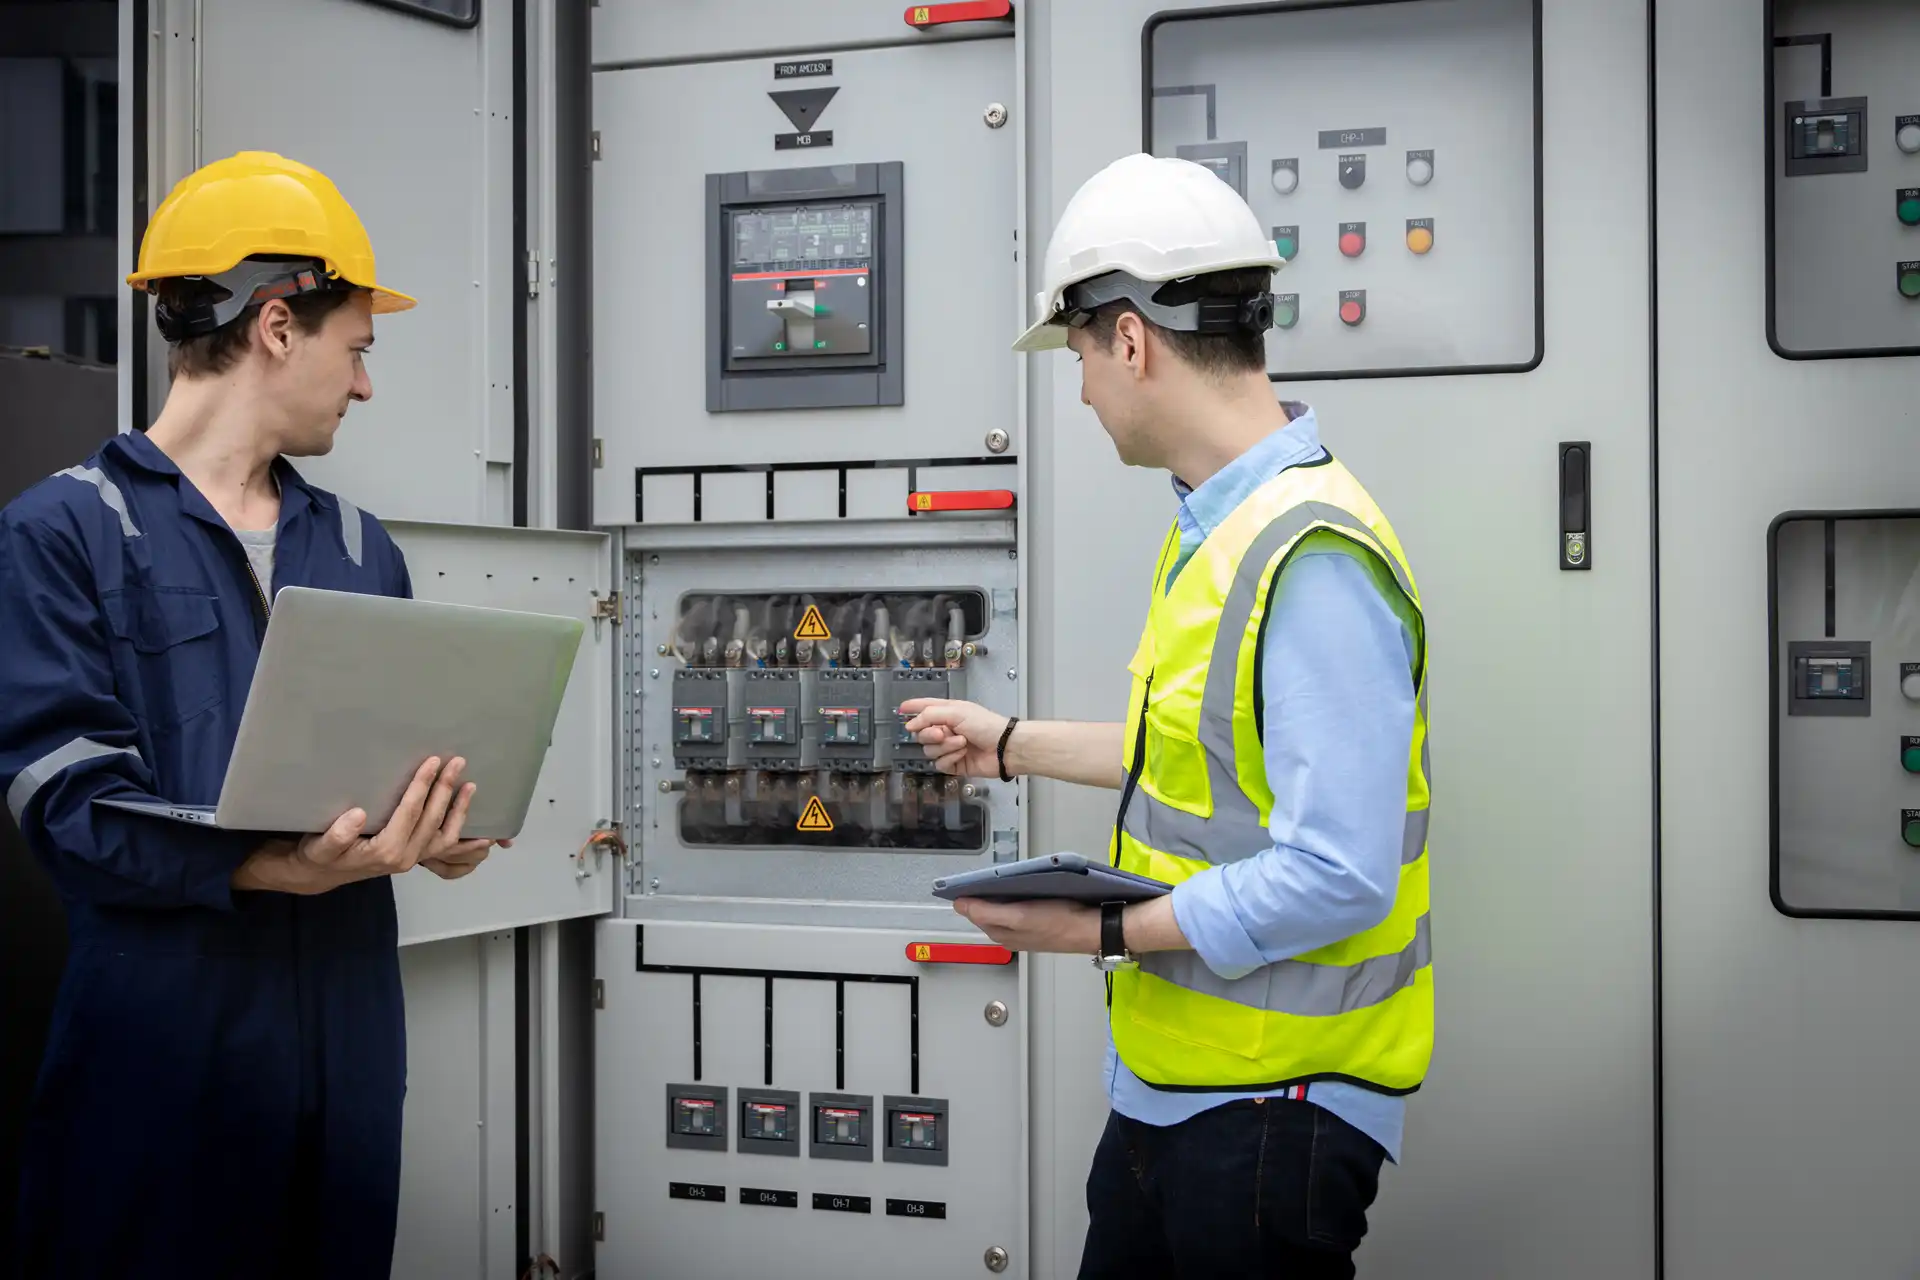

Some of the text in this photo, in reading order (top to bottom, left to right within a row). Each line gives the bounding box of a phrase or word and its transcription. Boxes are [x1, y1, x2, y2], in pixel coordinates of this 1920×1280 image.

[780, 65, 797, 75] FROM
[796, 135, 811, 145] MCB
[1902, 262, 1920, 270] STAR
[688, 1187, 706, 1197] CH-5
[760, 1193, 778, 1203] CH-6
[832, 1198, 850, 1208] CH-7
[906, 1203, 925, 1214] CH-8
